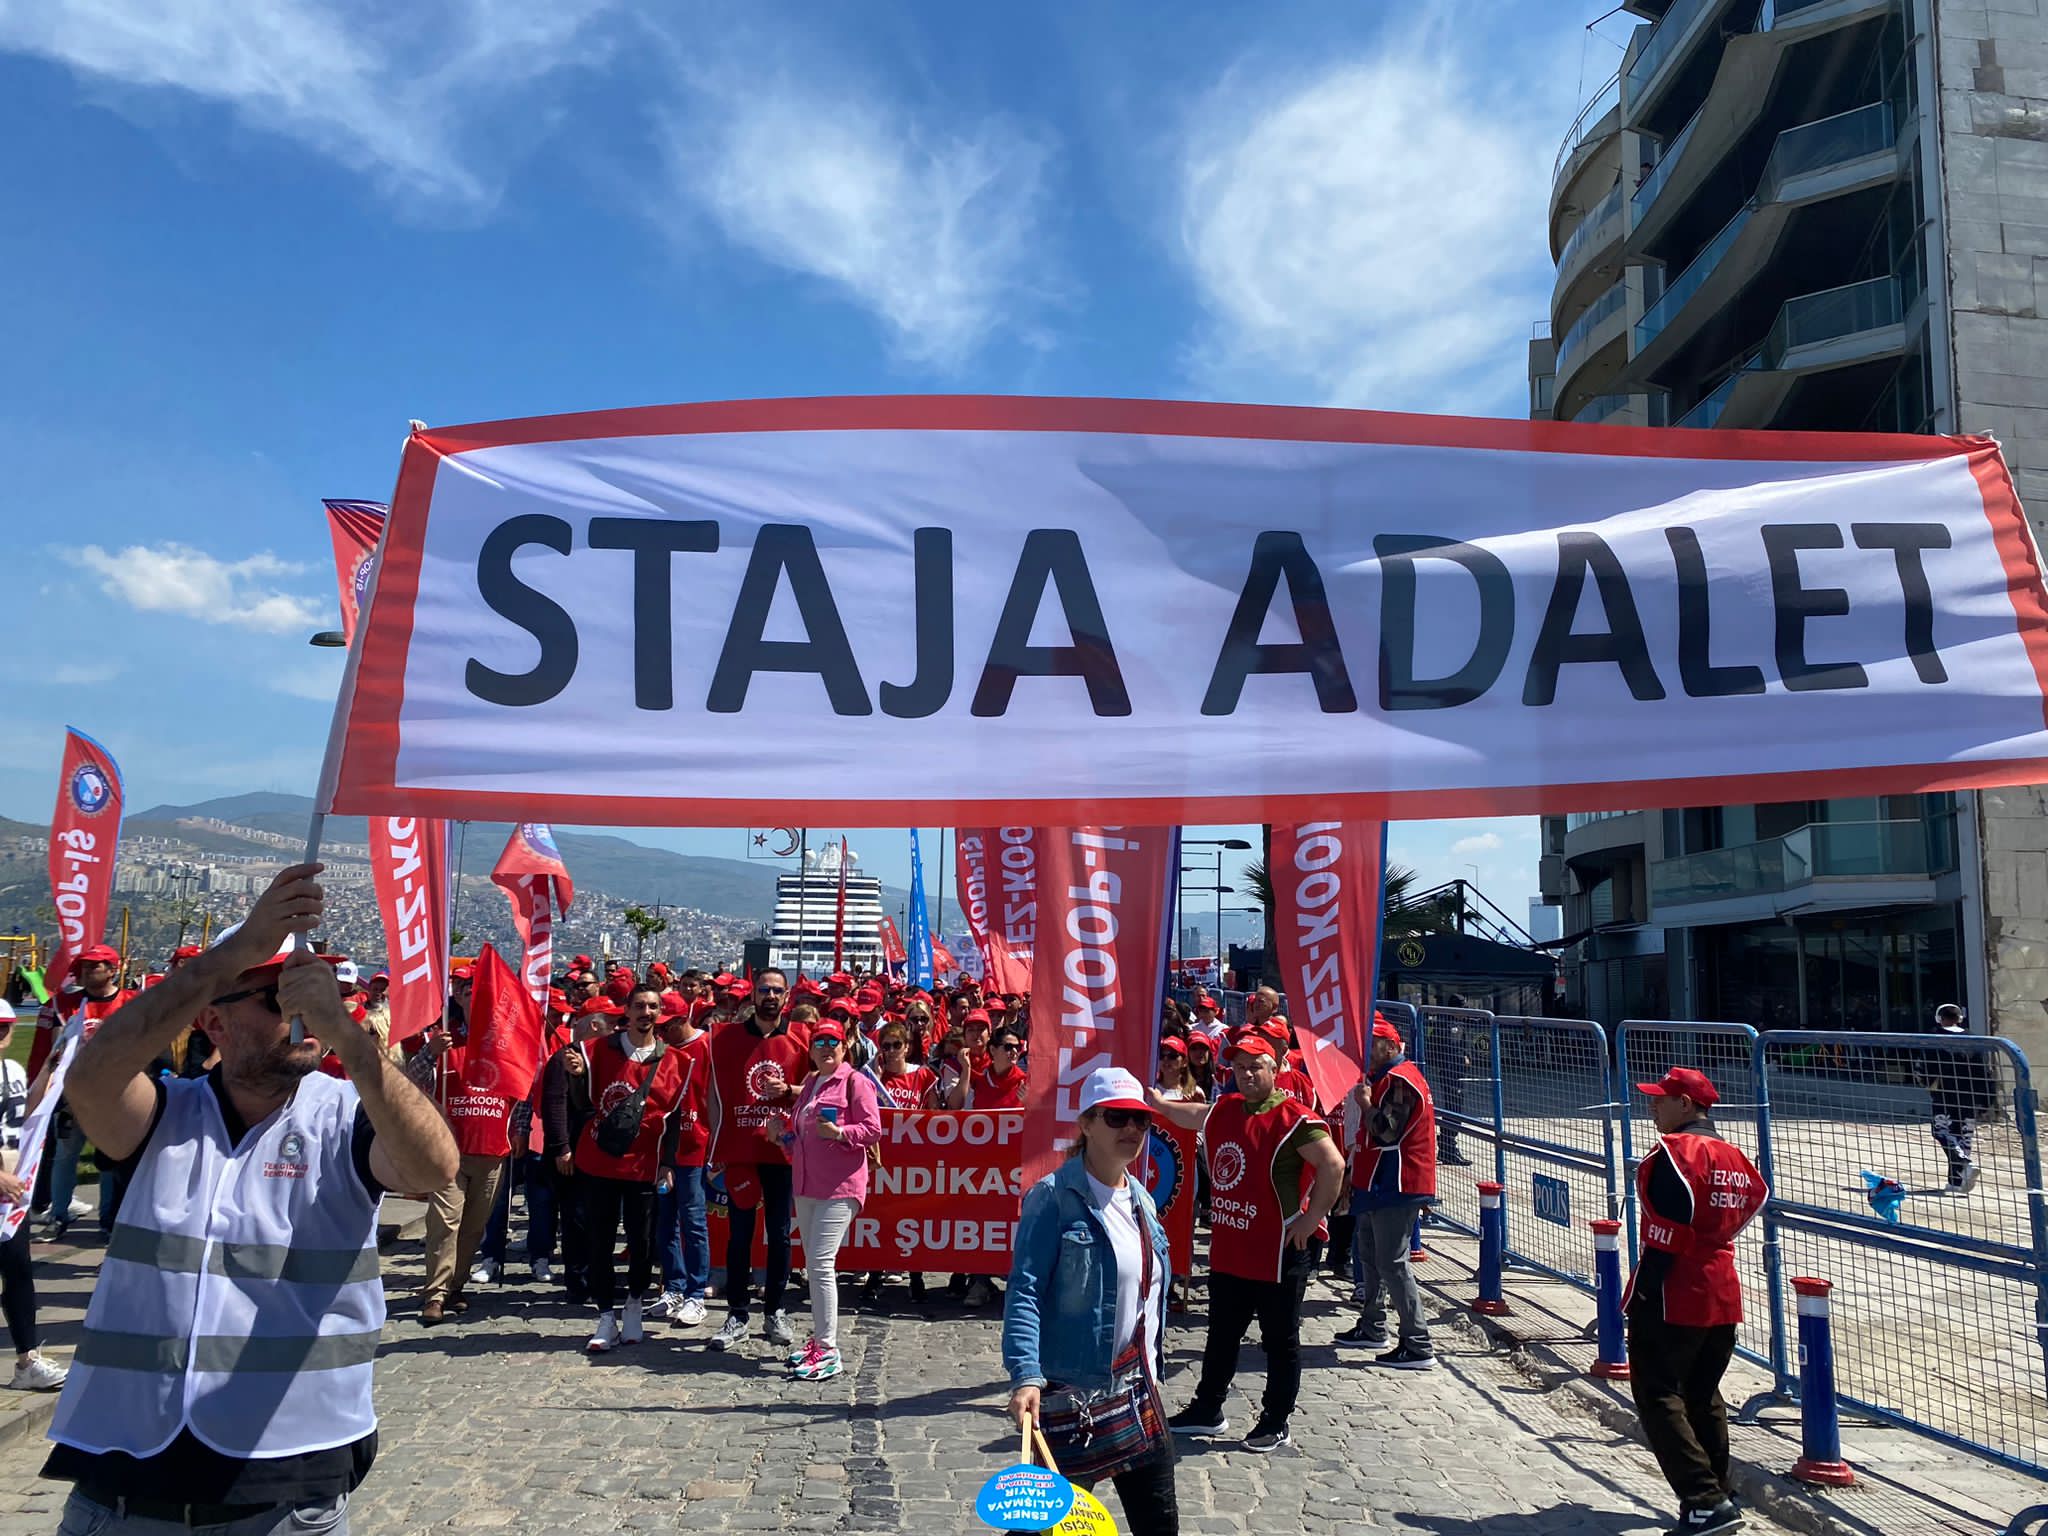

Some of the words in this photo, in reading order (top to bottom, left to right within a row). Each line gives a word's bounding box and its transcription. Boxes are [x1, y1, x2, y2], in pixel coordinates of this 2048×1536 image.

[464, 513, 1132, 719] STAJA
[1200, 522, 1952, 716] ADALET
[1534, 1181, 1568, 1220] POLİS
[1005, 1487, 1046, 1497] HAYIR
[988, 1498, 1063, 1511] ÇALIŞMAYA
[1003, 1511, 1049, 1521] ESNEK
